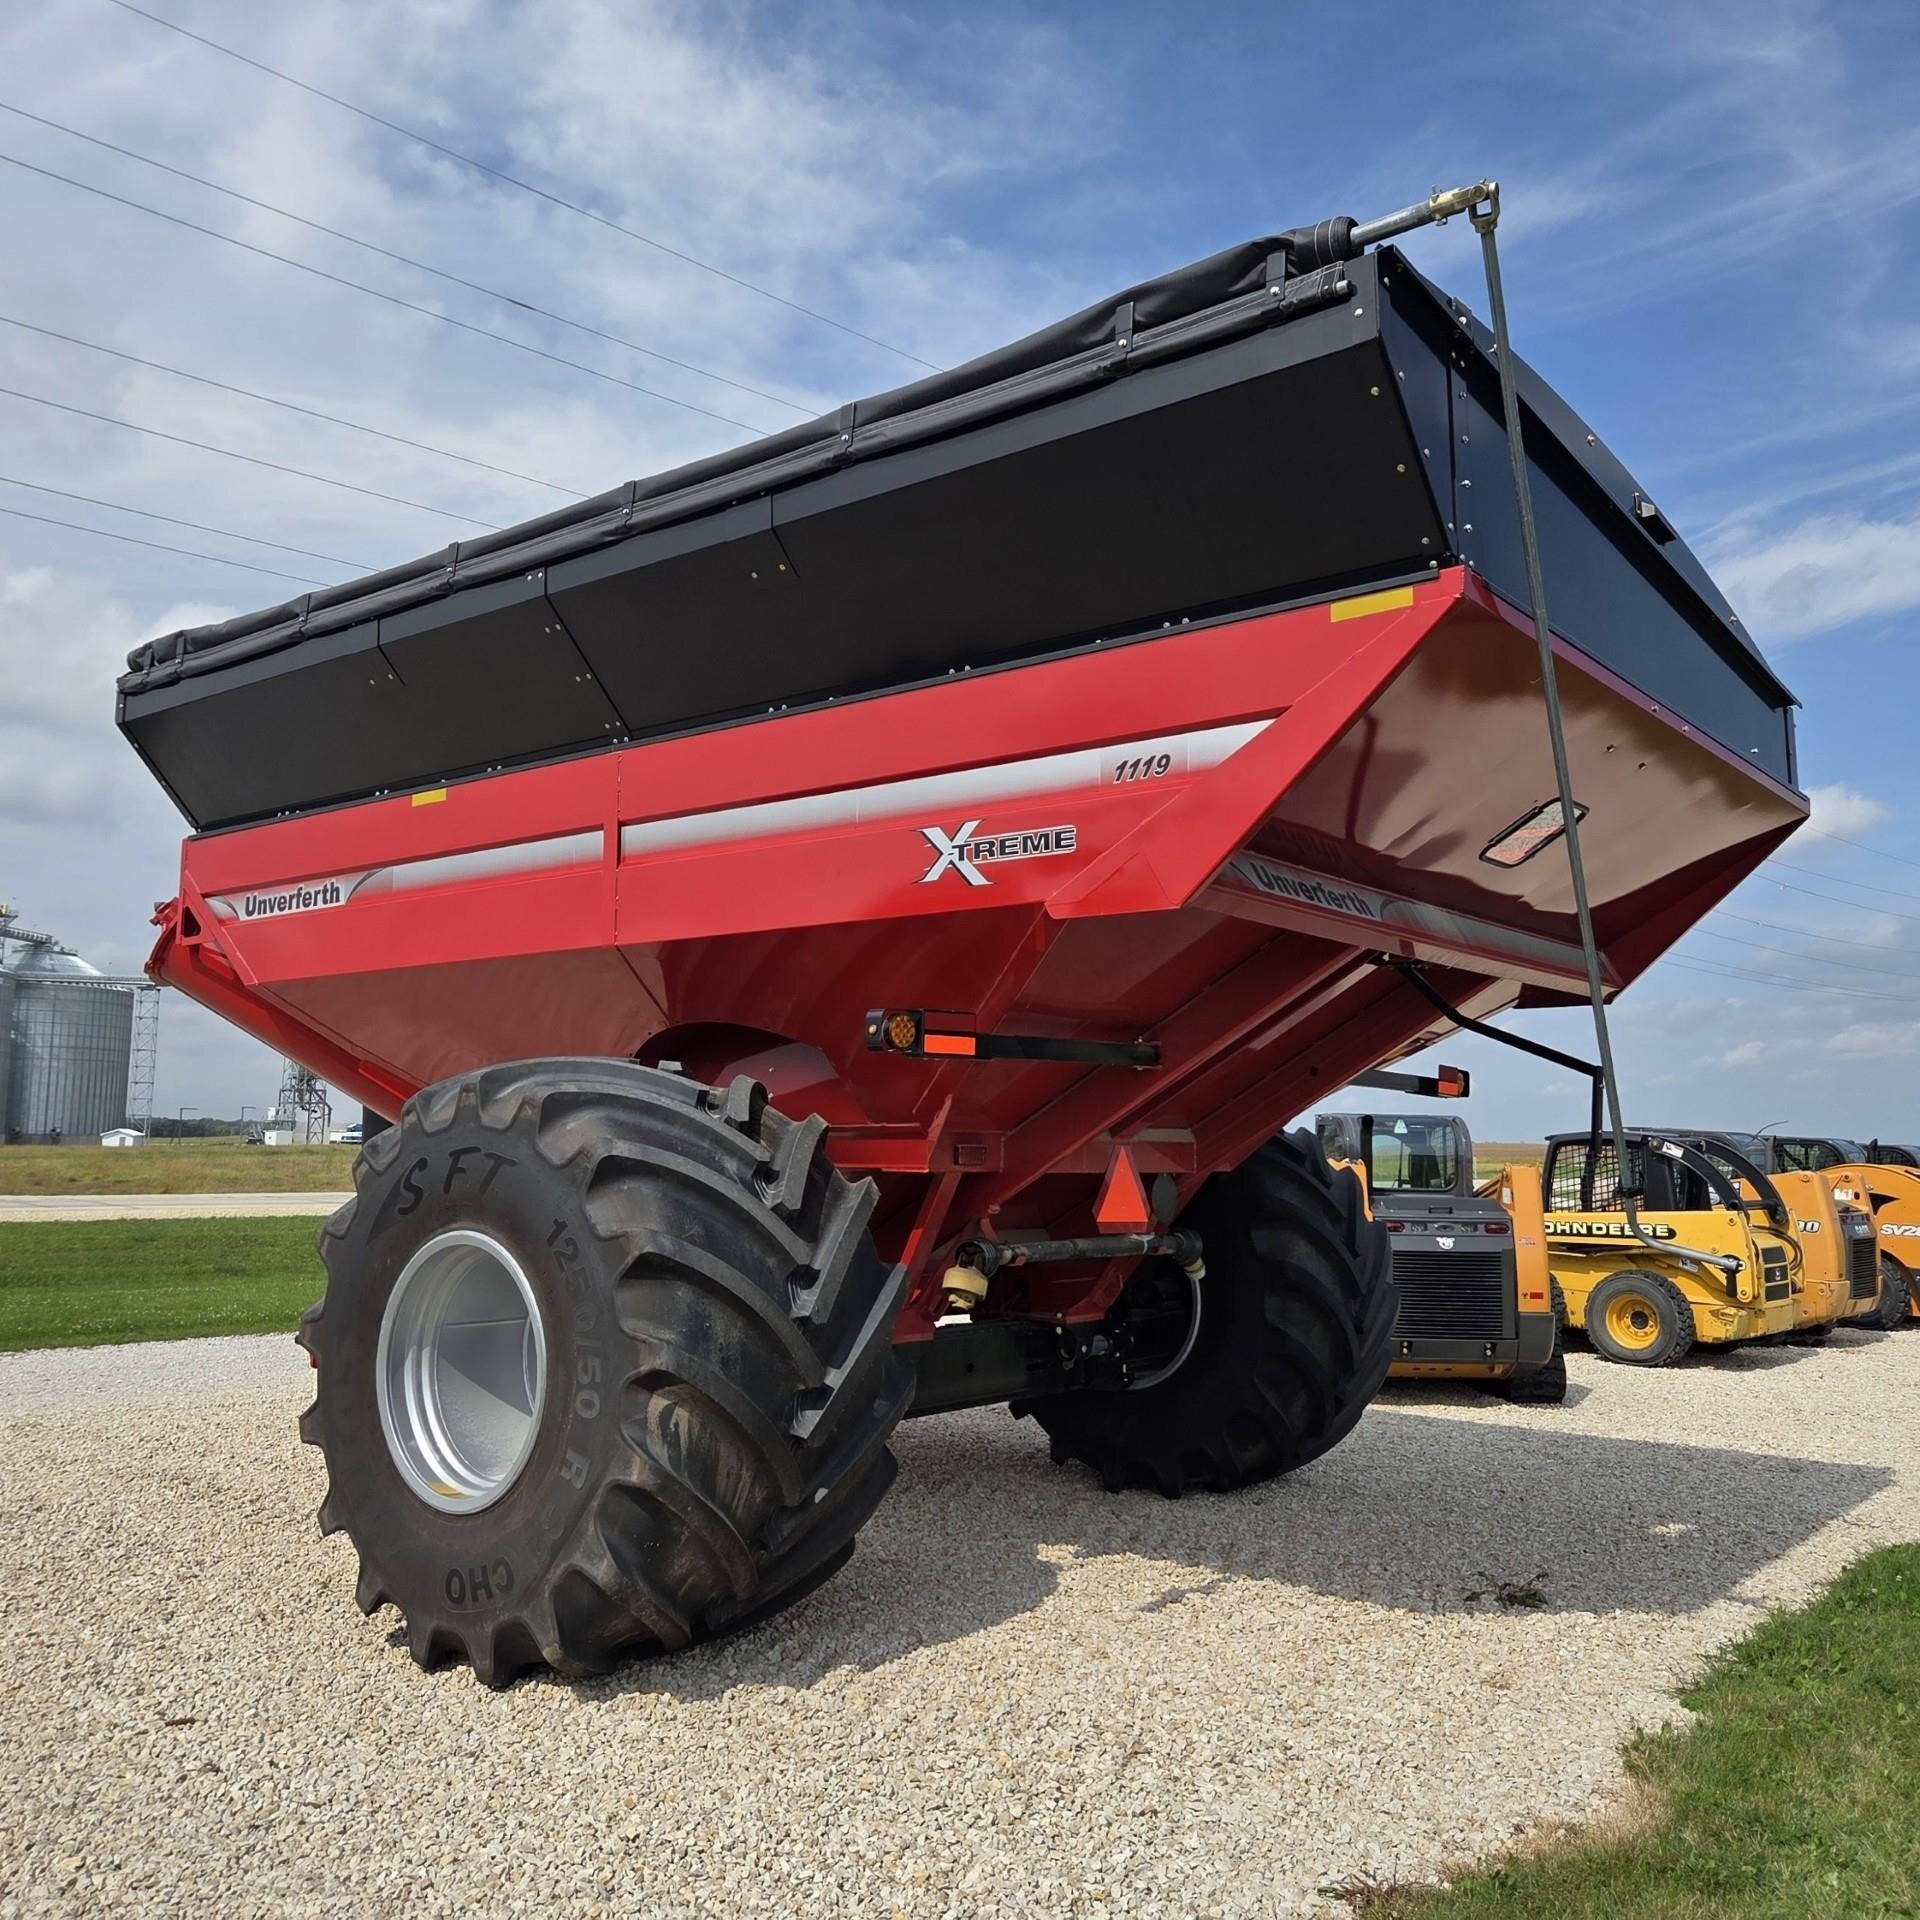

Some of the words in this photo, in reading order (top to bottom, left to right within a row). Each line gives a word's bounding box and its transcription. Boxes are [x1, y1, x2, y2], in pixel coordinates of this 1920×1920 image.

[1114, 753, 1172, 783] 1119
[244, 881, 341, 917] Unverferth
[1251, 862, 1376, 918] Unverferth
[397, 1146, 519, 1215] SFT
[1544, 1221, 1587, 1235] OHN
[445, 1556, 514, 1604] CHO
